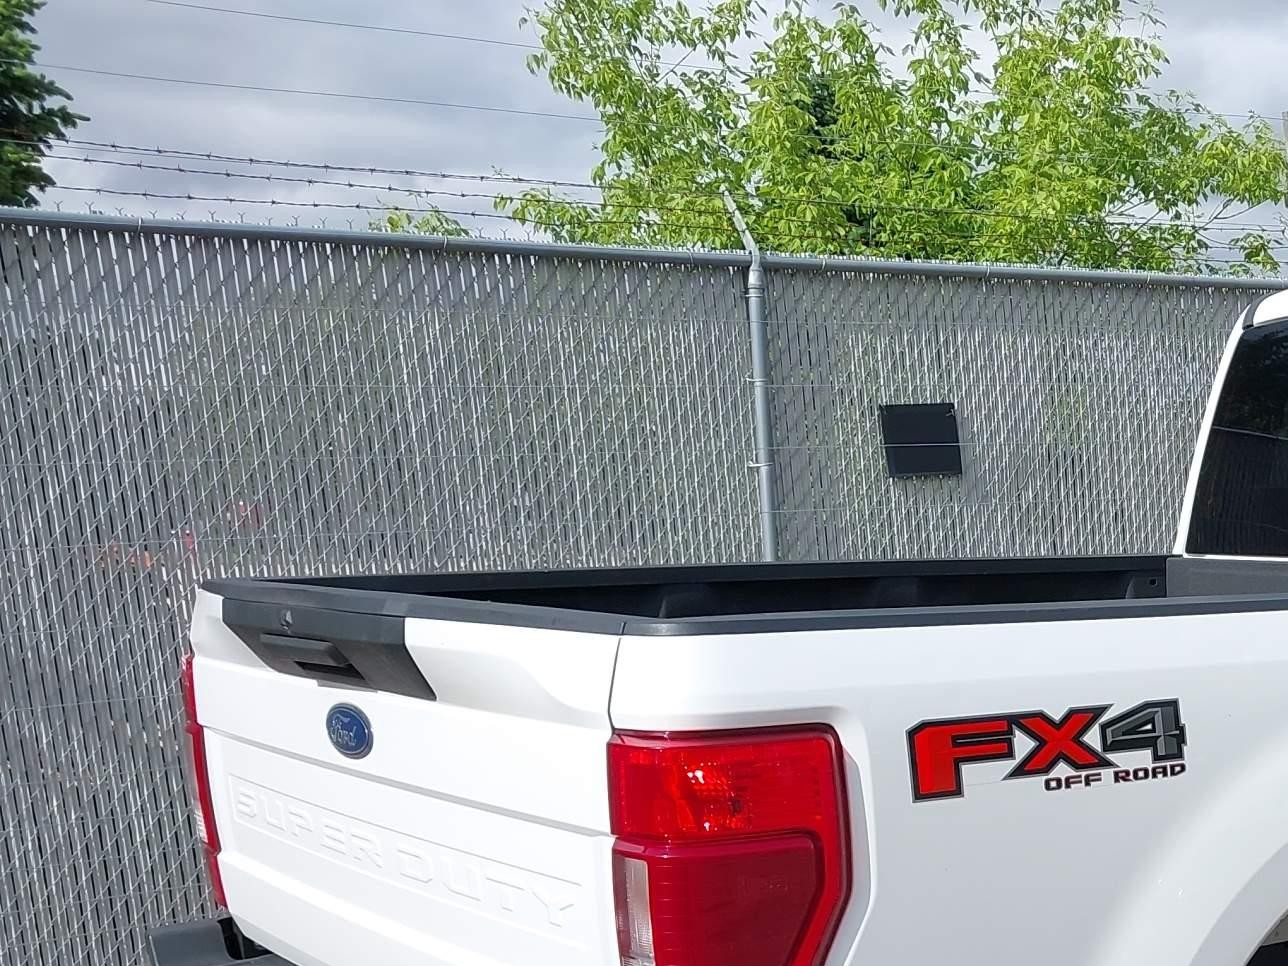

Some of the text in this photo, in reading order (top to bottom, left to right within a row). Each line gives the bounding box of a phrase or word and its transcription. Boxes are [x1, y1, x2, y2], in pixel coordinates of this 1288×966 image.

[905, 697, 1187, 803] FX4
[1043, 762, 1187, 792] OFF ROAD
[235, 788, 576, 929] SUPER DUTY
